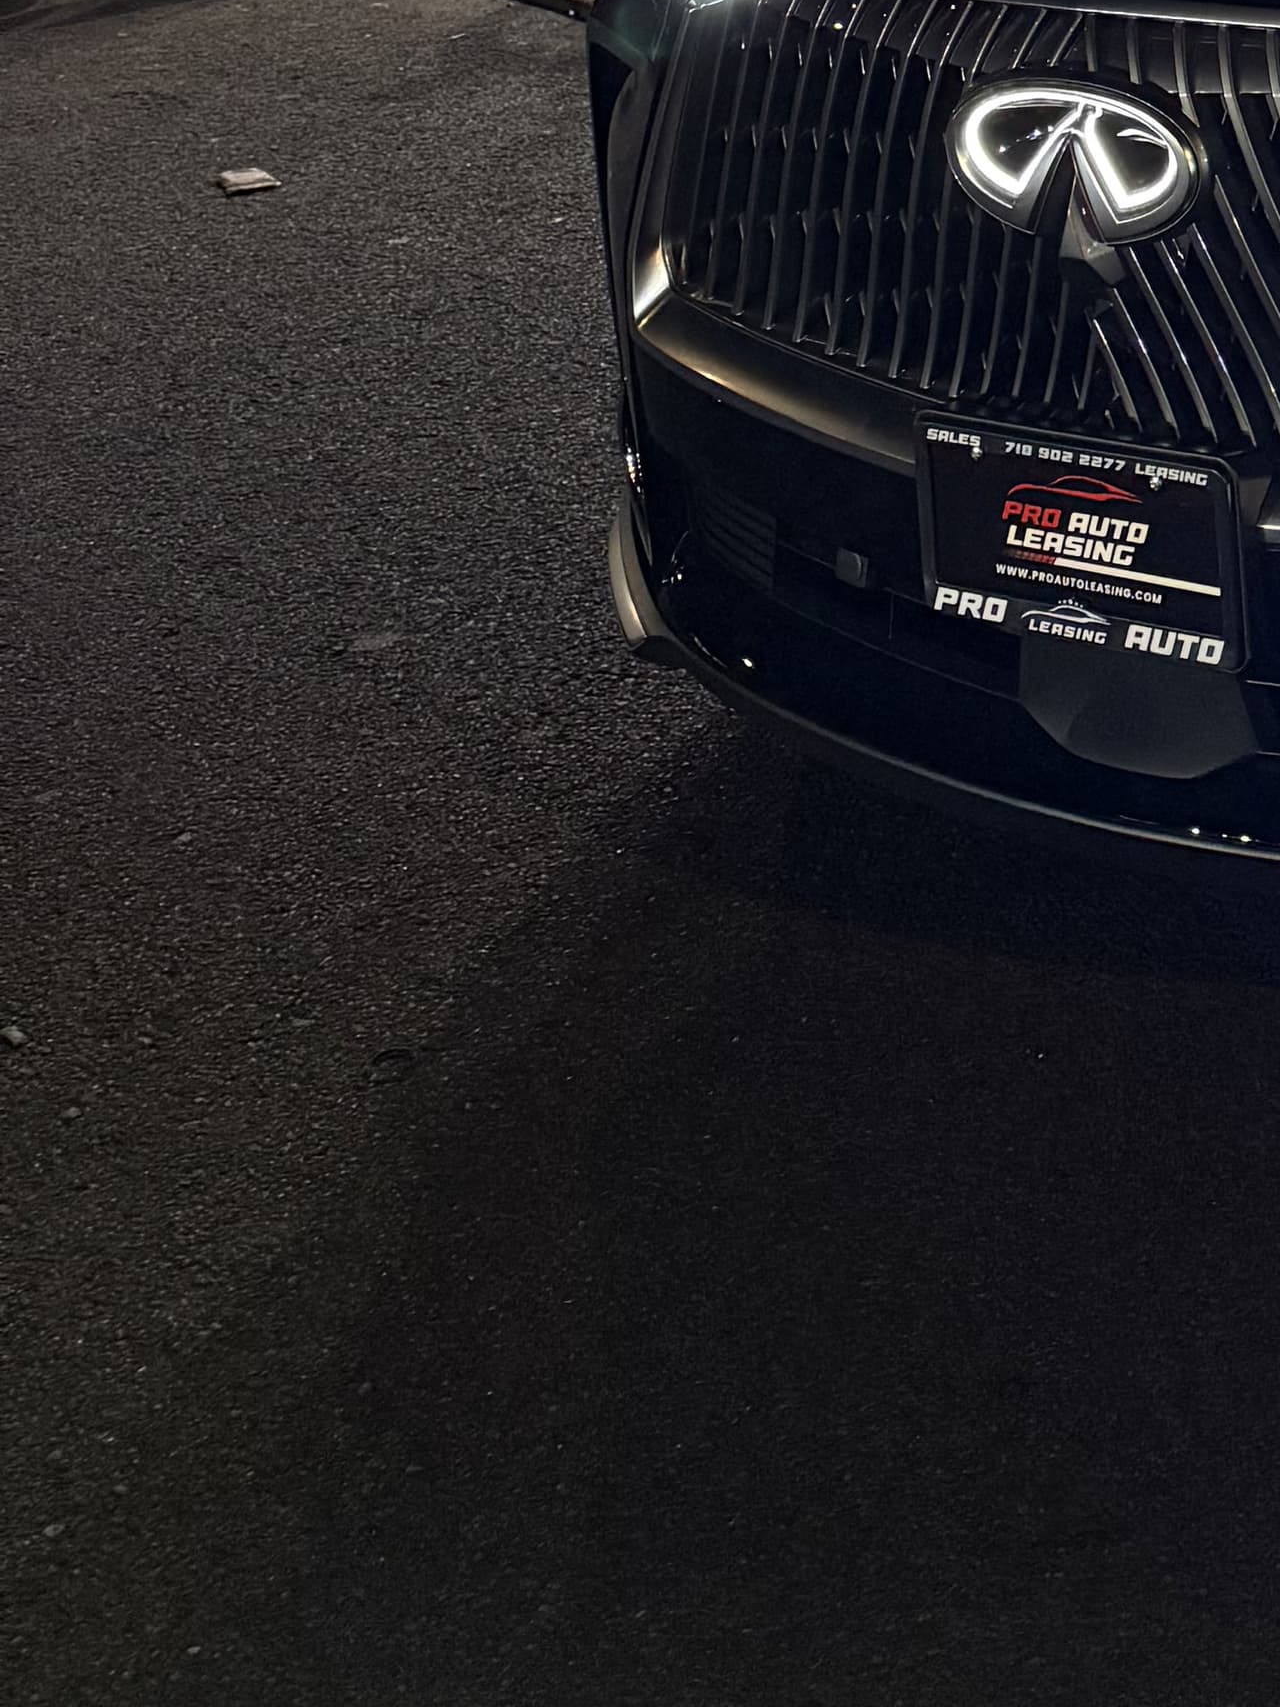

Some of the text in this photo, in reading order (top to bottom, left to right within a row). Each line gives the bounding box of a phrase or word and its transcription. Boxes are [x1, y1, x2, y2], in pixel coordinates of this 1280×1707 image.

[926, 429, 981, 447] SALES
[1038, 446, 1073, 463] 902
[1079, 453, 1125, 472] 2277
[1135, 462, 1208, 486] LEASING
[1002, 500, 1149, 545] PRO AUTO
[1006, 524, 1136, 566] LEASING
[995, 563, 1162, 604] WWW.PROAUTOLEASING.COM
[933, 587, 1225, 665] PRO LEASING AUTO
